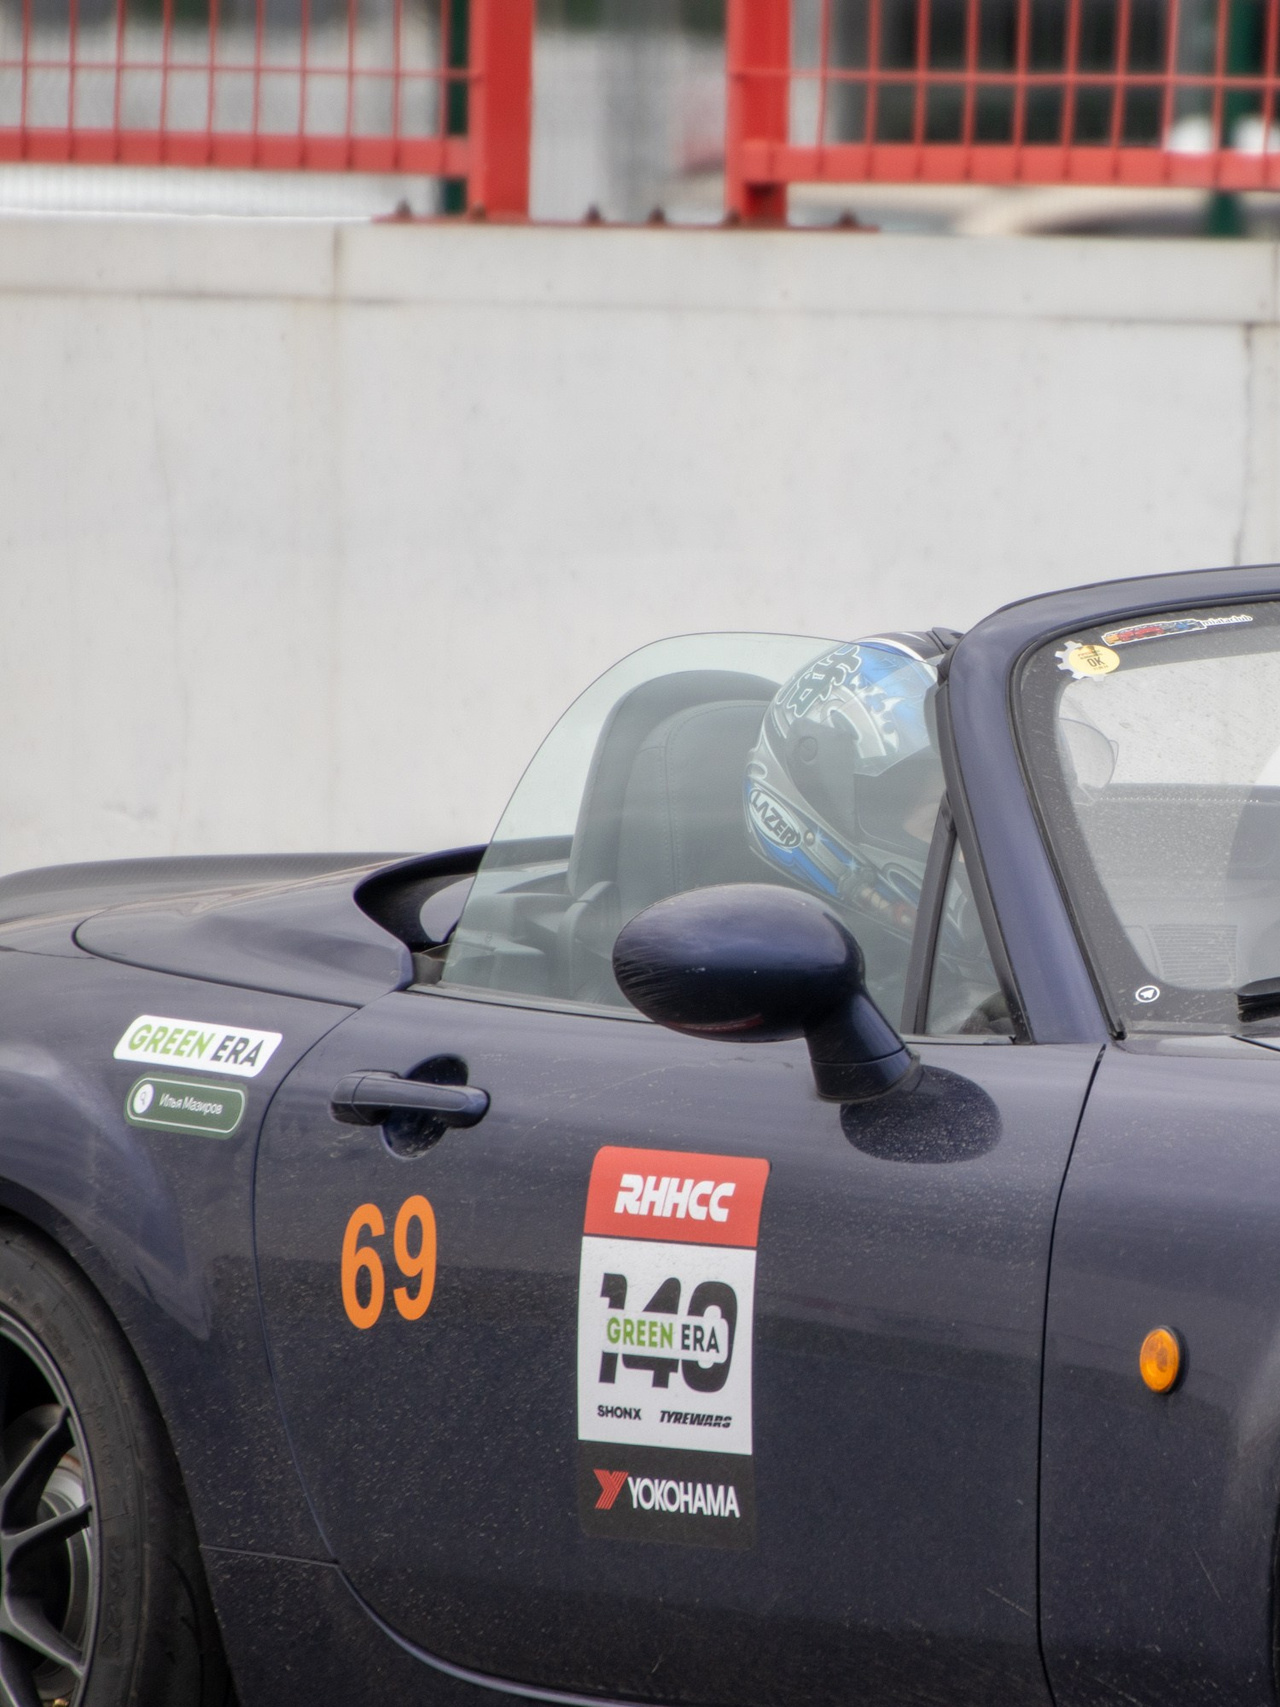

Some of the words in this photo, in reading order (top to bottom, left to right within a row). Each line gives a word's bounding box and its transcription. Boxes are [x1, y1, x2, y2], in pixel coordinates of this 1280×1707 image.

[1086, 656, 1106, 668] OK
[750, 791, 802, 847] LAZER
[128, 1023, 216, 1059] GREEN
[211, 1034, 264, 1067] ERA
[159, 1093, 183, 1109] Илья
[182, 1096, 224, 1116] Мазиров
[614, 1174, 736, 1222] RHHCC
[341, 1194, 437, 1330] 69
[606, 1316, 674, 1348] GREEN
[680, 1323, 720, 1354] ERA
[597, 1404, 642, 1420] SHONX
[659, 1410, 733, 1428] TYREWARS
[627, 1476, 740, 1518] YOKOHAMA
